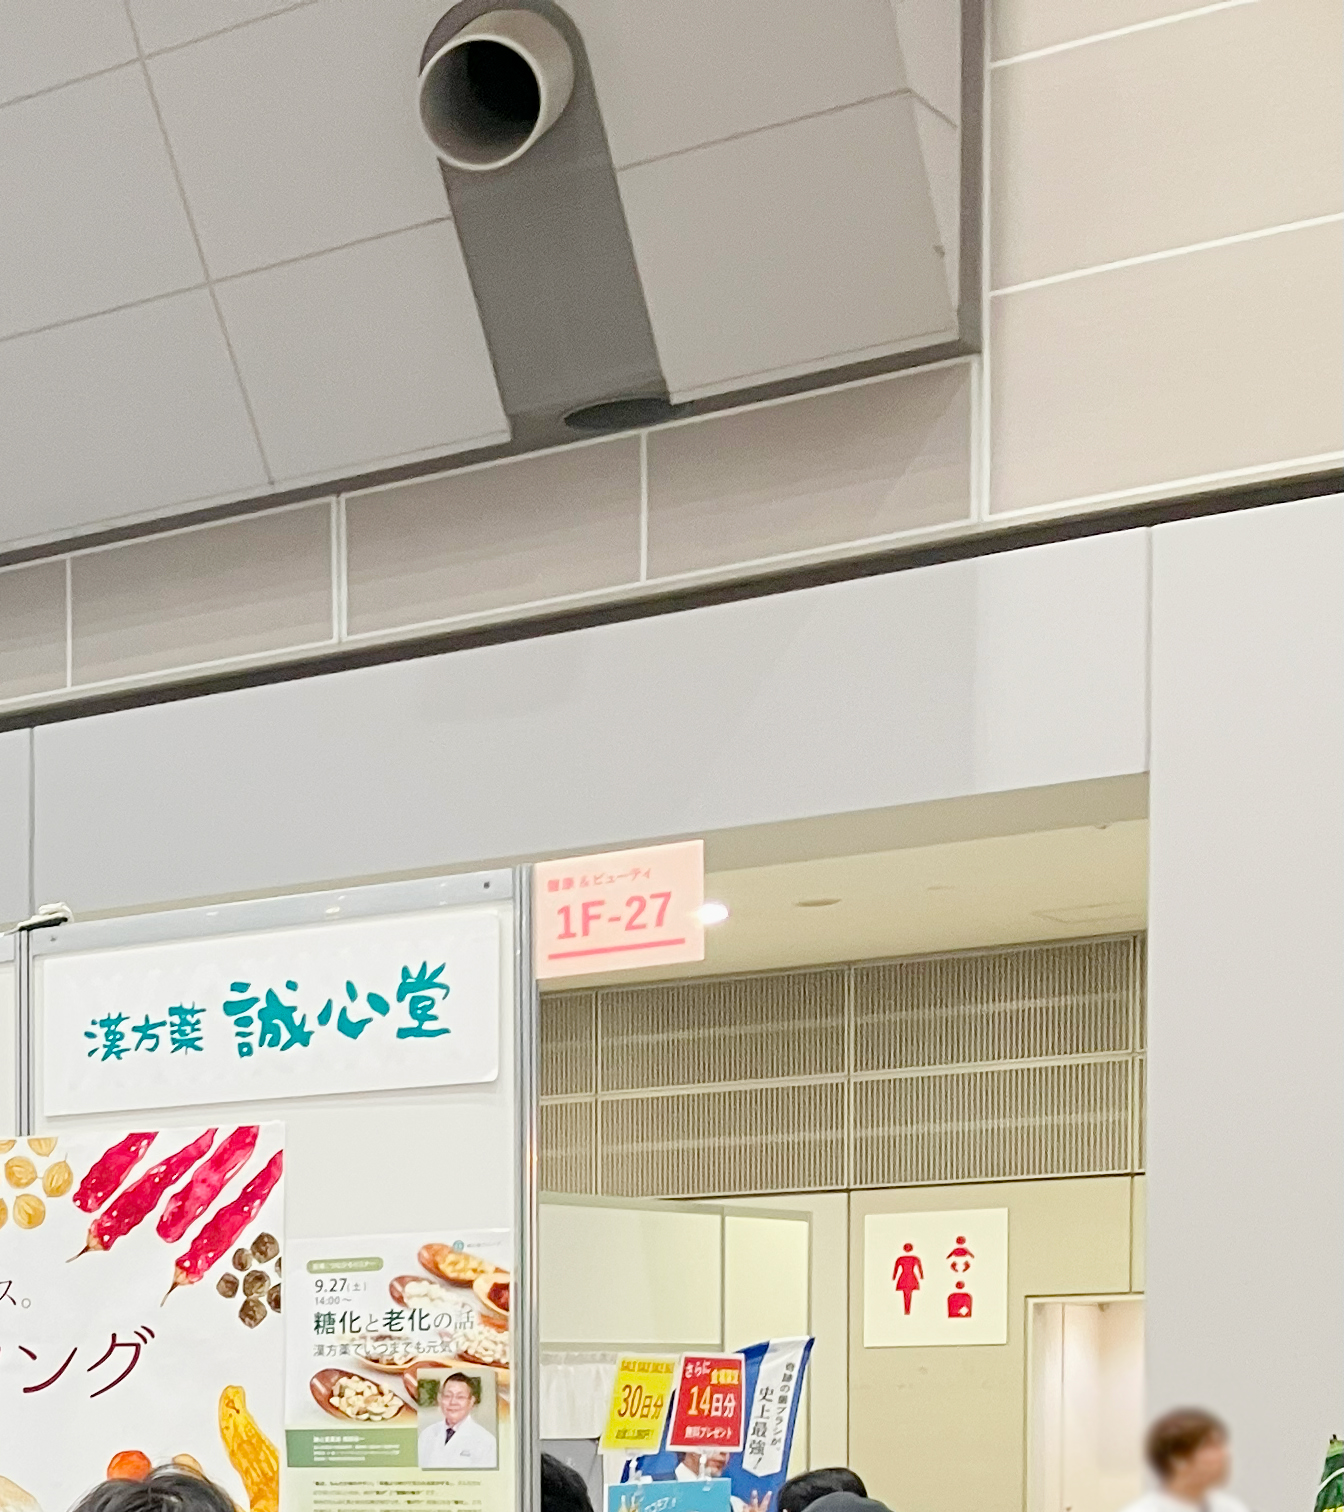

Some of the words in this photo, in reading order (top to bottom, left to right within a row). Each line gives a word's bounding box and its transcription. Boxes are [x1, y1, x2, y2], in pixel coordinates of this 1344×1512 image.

[557, 891, 672, 939] 1F-27
[84, 1001, 207, 1061] 漢方薬
[223, 961, 451, 1057] 誠心堂
[313, 1303, 475, 1336] 糖化と老化の話
[685, 1360, 711, 1379] さらに
[618, 1384, 664, 1420] 30日分
[687, 1385, 737, 1418] 14日分
